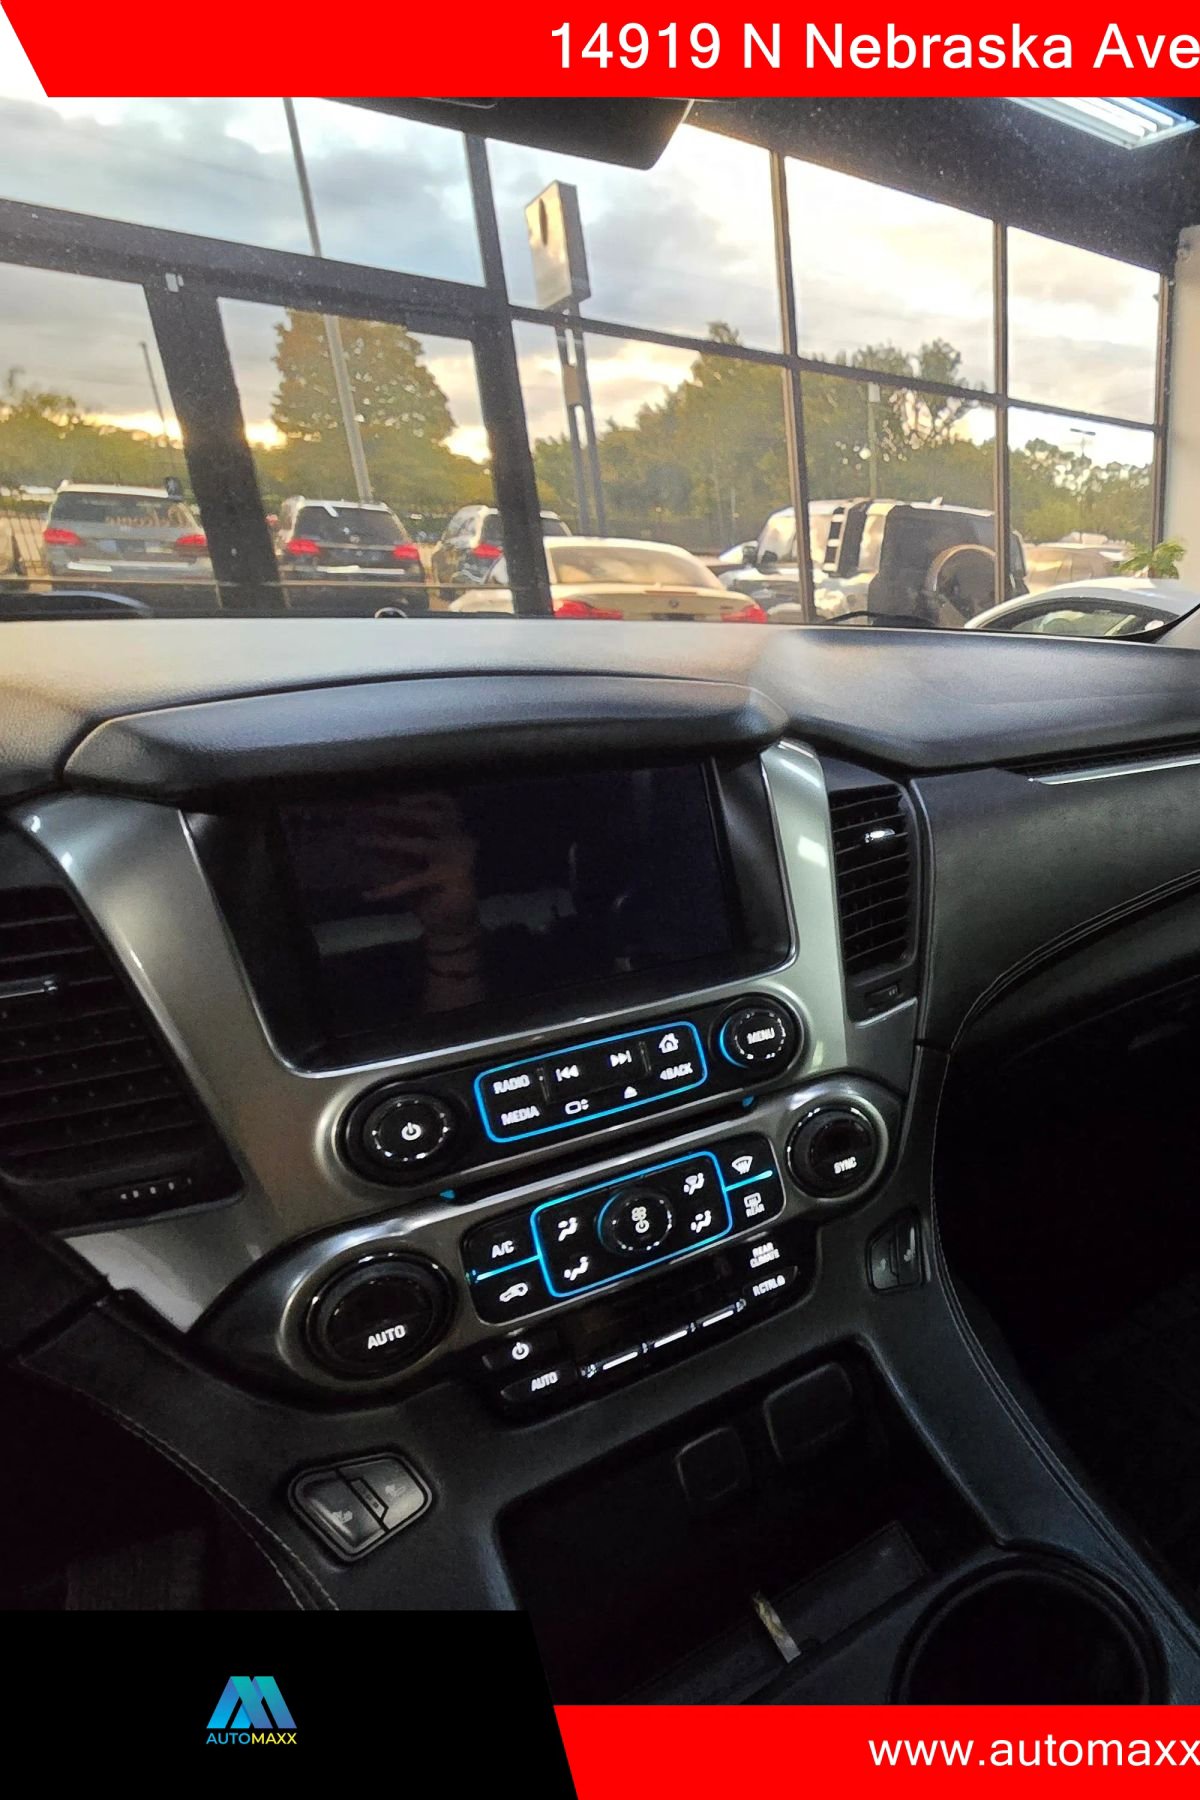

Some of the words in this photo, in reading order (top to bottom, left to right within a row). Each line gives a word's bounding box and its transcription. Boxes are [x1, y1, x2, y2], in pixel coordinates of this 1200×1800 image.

[747, 1027, 776, 1045] MENU
[493, 1074, 531, 1095] RADIO
[501, 1105, 540, 1126] MEDIA
[833, 1156, 858, 1175] SYNC
[491, 1240, 515, 1259] A/C
[367, 1324, 406, 1350] AUTO
[531, 1371, 559, 1392] AUTO
